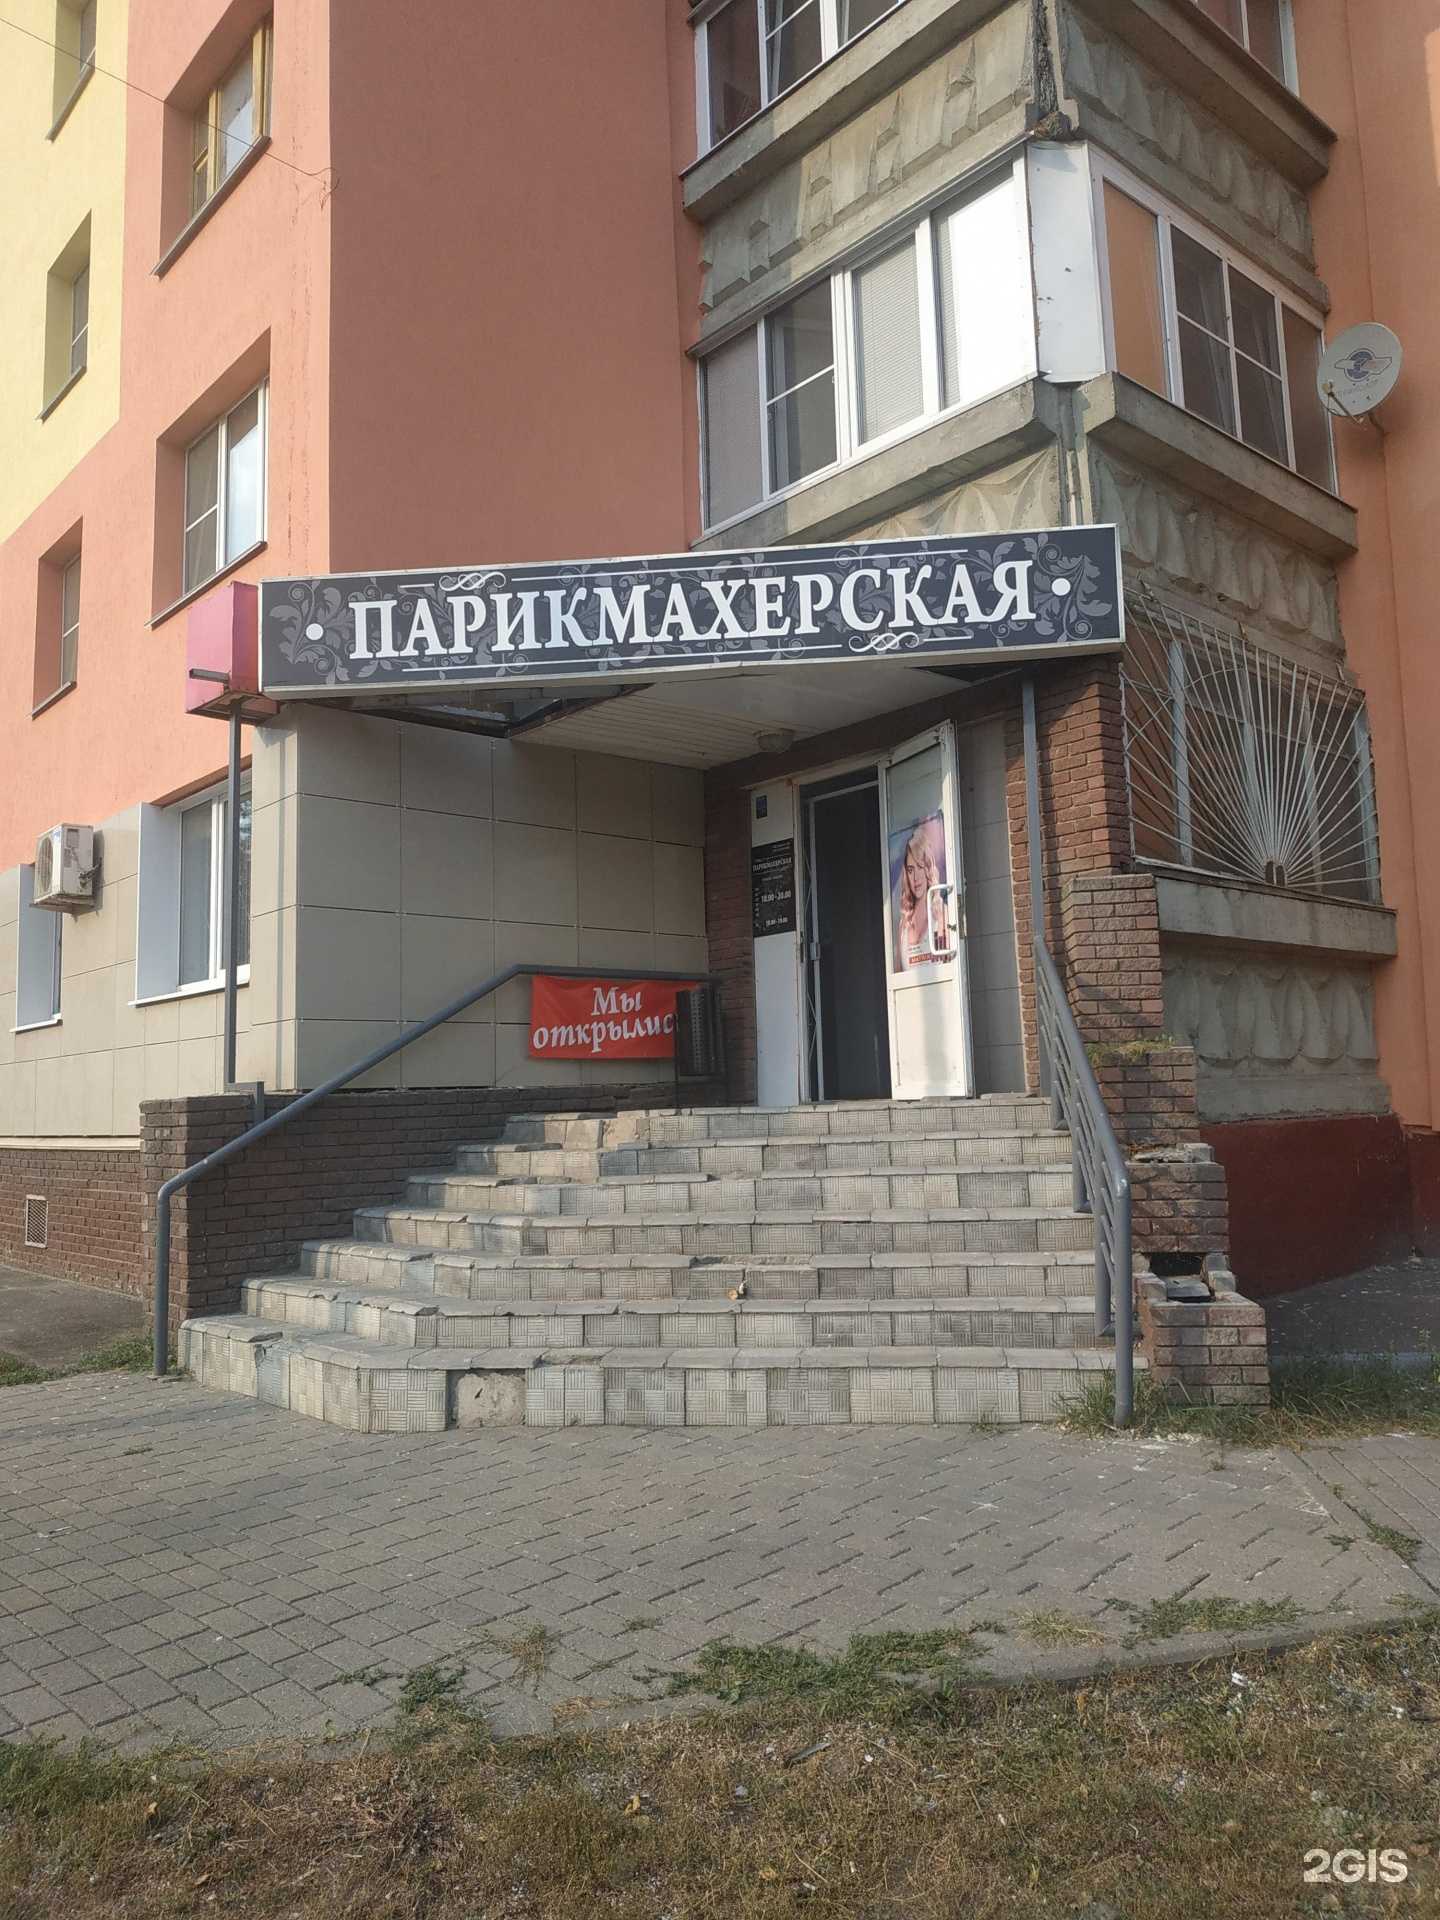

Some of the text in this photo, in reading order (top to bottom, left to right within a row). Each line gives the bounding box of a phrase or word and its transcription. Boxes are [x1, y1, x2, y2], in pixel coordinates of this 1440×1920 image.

[348, 559, 1037, 660] ПАРИКМАХЕРСКАЯ
[590, 986, 642, 1016] Мы
[532, 1012, 678, 1053] открылис
